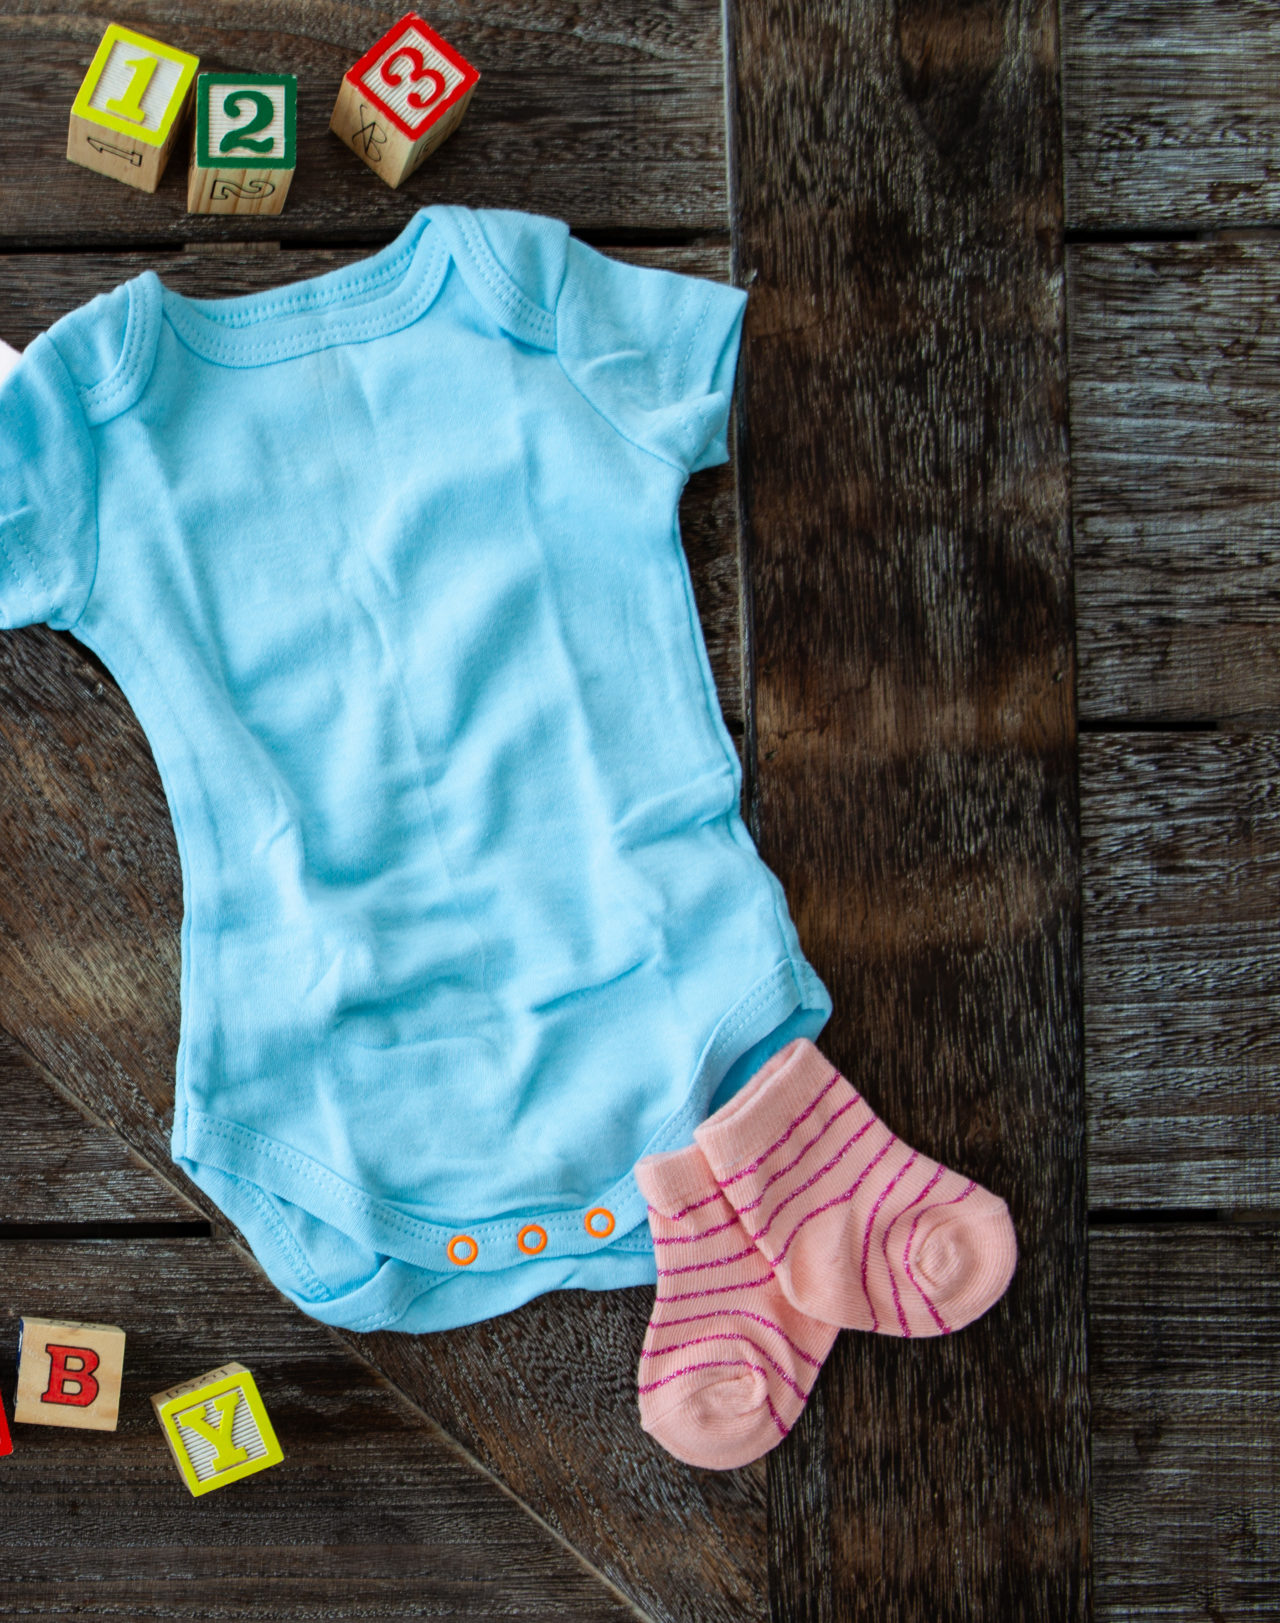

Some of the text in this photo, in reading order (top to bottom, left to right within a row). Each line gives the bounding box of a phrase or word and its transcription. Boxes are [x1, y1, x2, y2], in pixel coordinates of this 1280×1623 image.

[106, 56, 158, 124] 1
[381, 46, 447, 110] 3
[220, 89, 275, 154] 2
